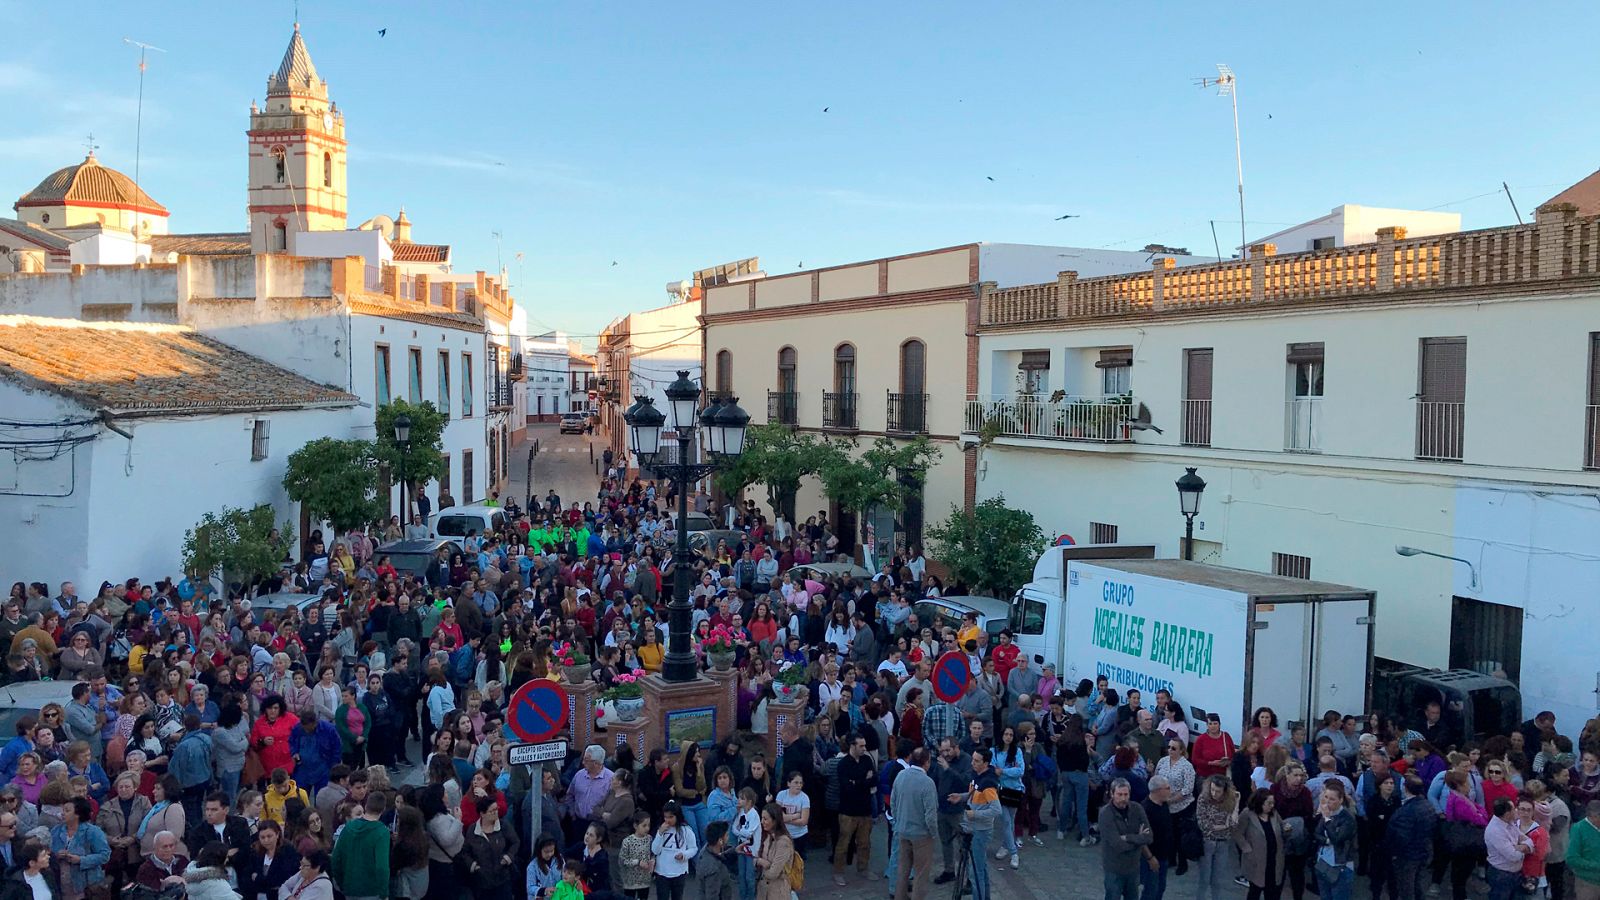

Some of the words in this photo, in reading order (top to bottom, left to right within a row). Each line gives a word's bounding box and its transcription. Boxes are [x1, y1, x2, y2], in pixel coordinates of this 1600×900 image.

[1103, 580, 1134, 607] GRUPO
[1092, 607, 1145, 658] NOGALES
[1150, 620, 1214, 679] BARRERA
[1096, 660, 1174, 698] DISTRIBUCIONES
[511, 754, 533, 763] OFICIALES
[537, 750, 566, 760] AUTORIZADOS
[517, 745, 536, 755] EXCEPTO
